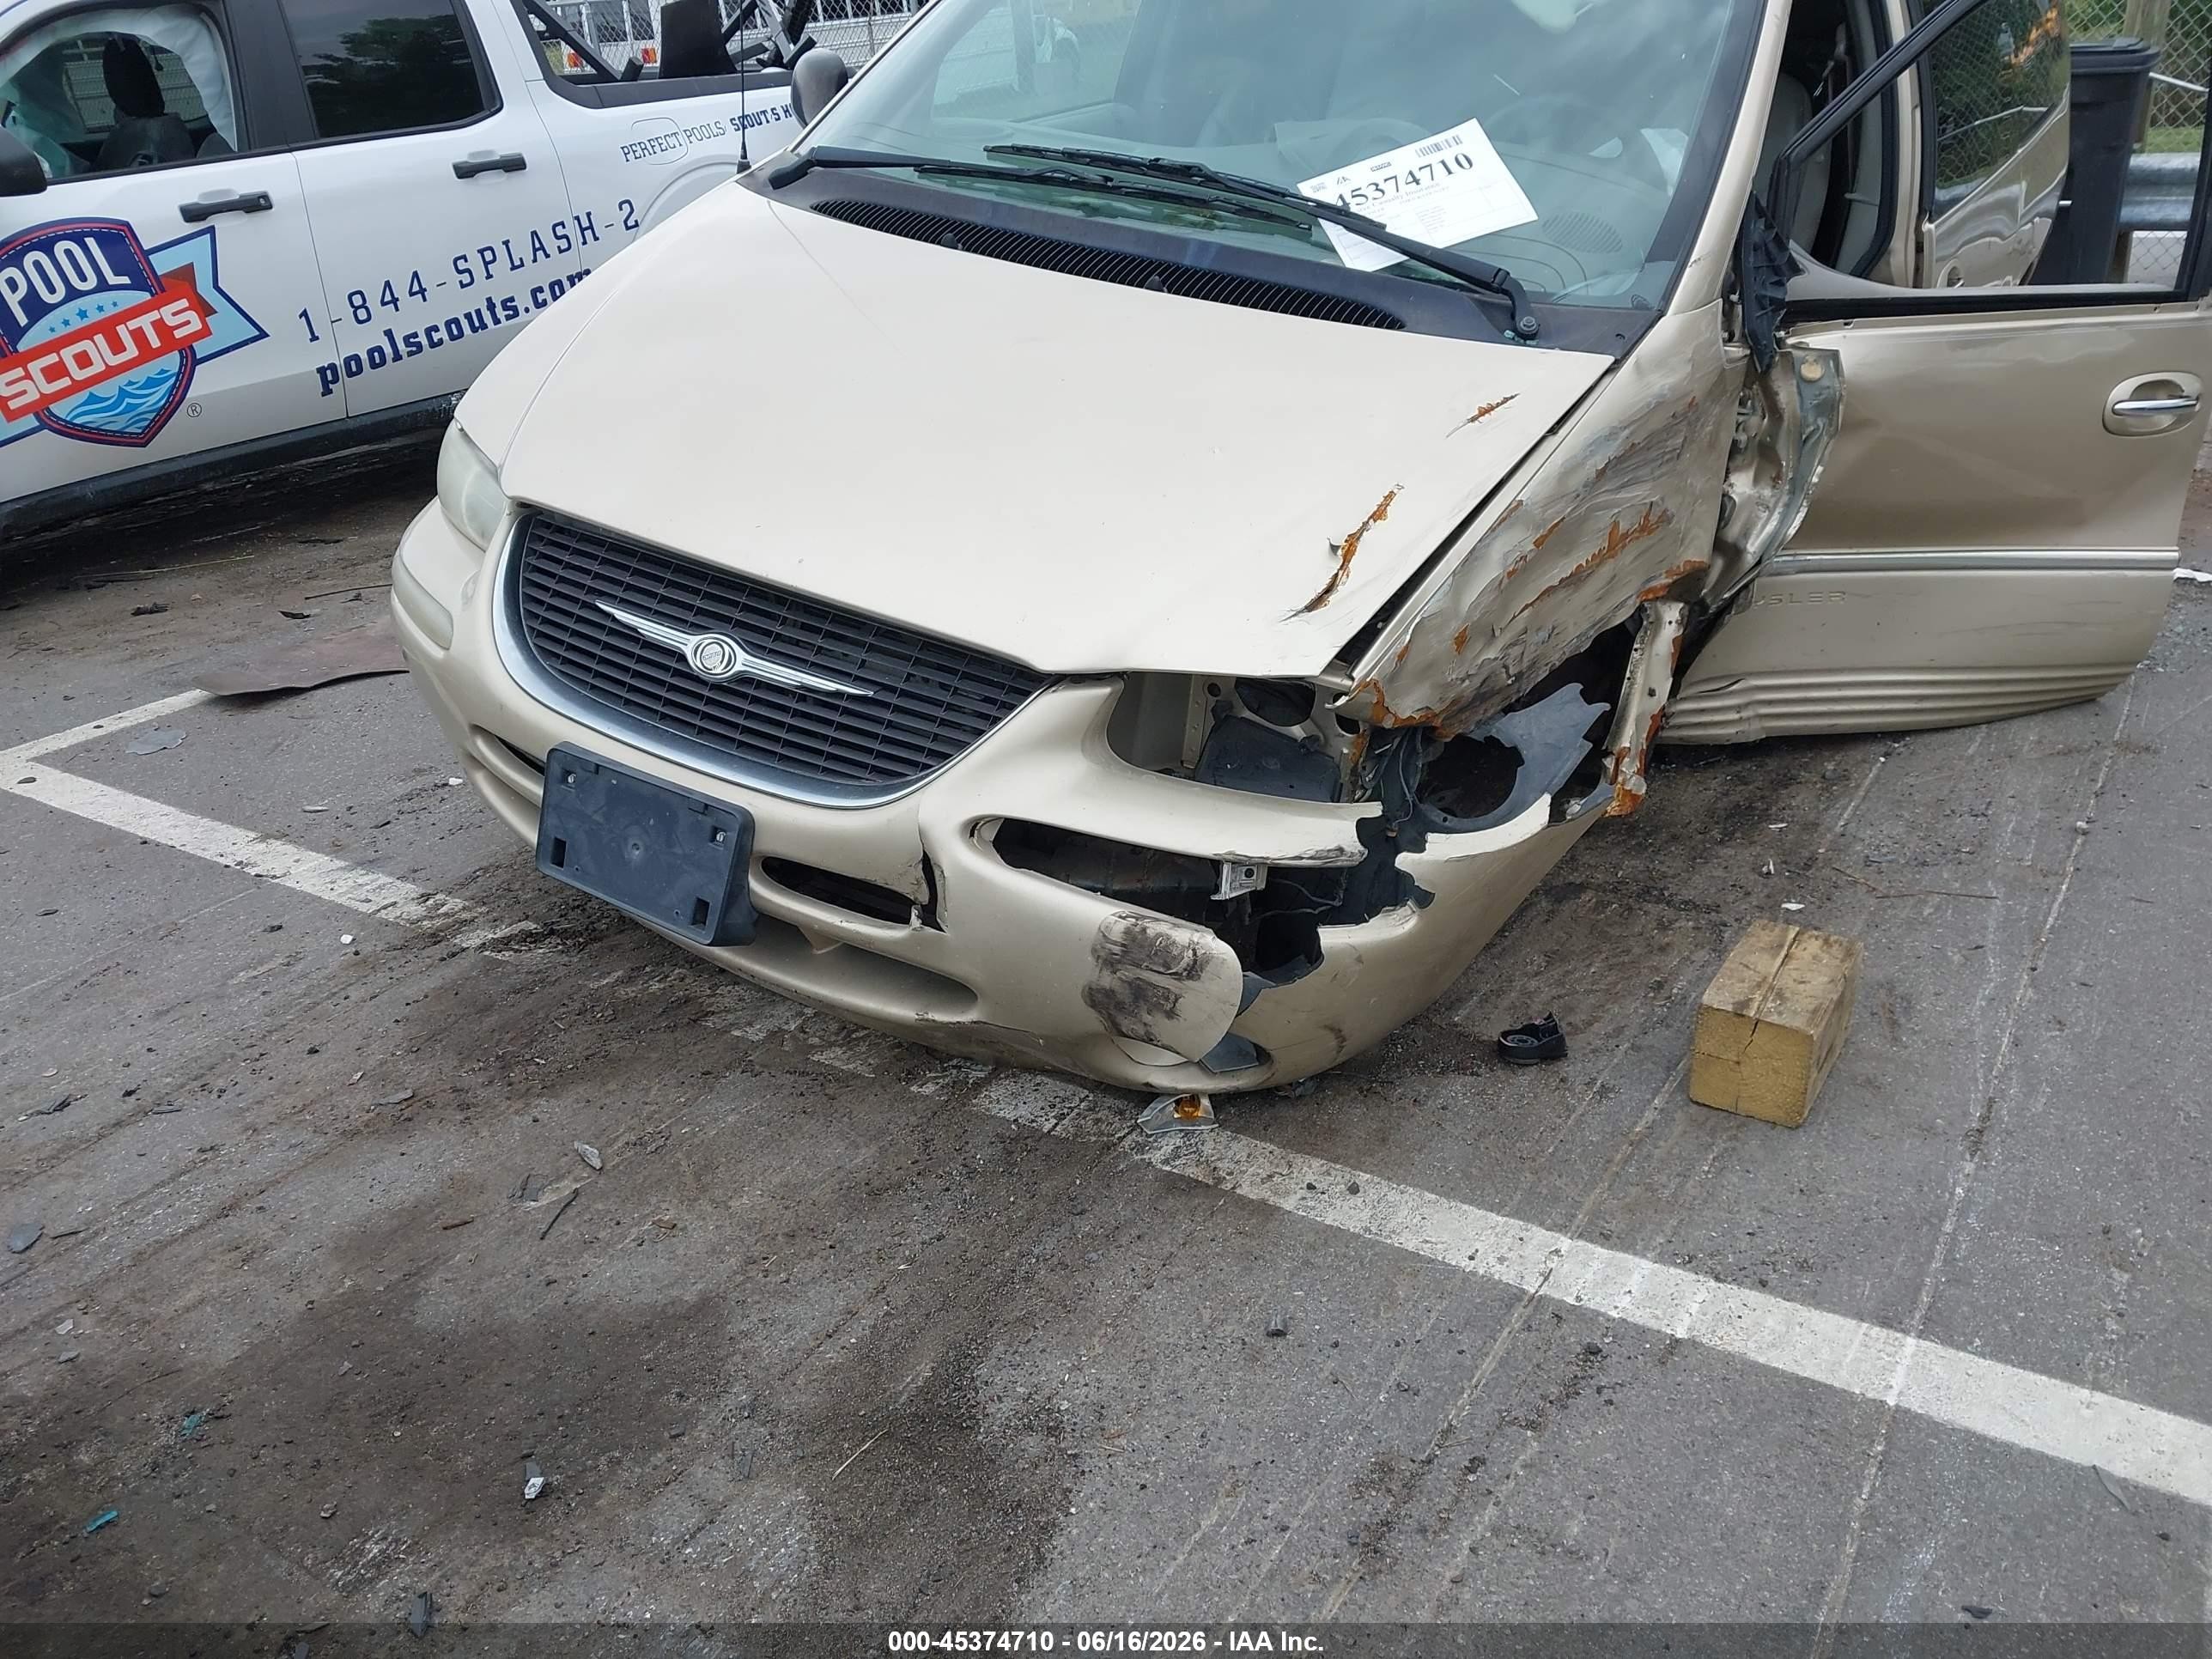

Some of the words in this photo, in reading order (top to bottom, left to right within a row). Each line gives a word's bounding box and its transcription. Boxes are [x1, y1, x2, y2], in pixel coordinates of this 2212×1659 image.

[620, 132, 684, 162] PERFECT
[1335, 153, 1474, 207] 45374710
[0, 237, 131, 328] POOL
[298, 198, 640, 343] 1-844-SPLASH-2
[0, 299, 203, 410] SCOUTS
